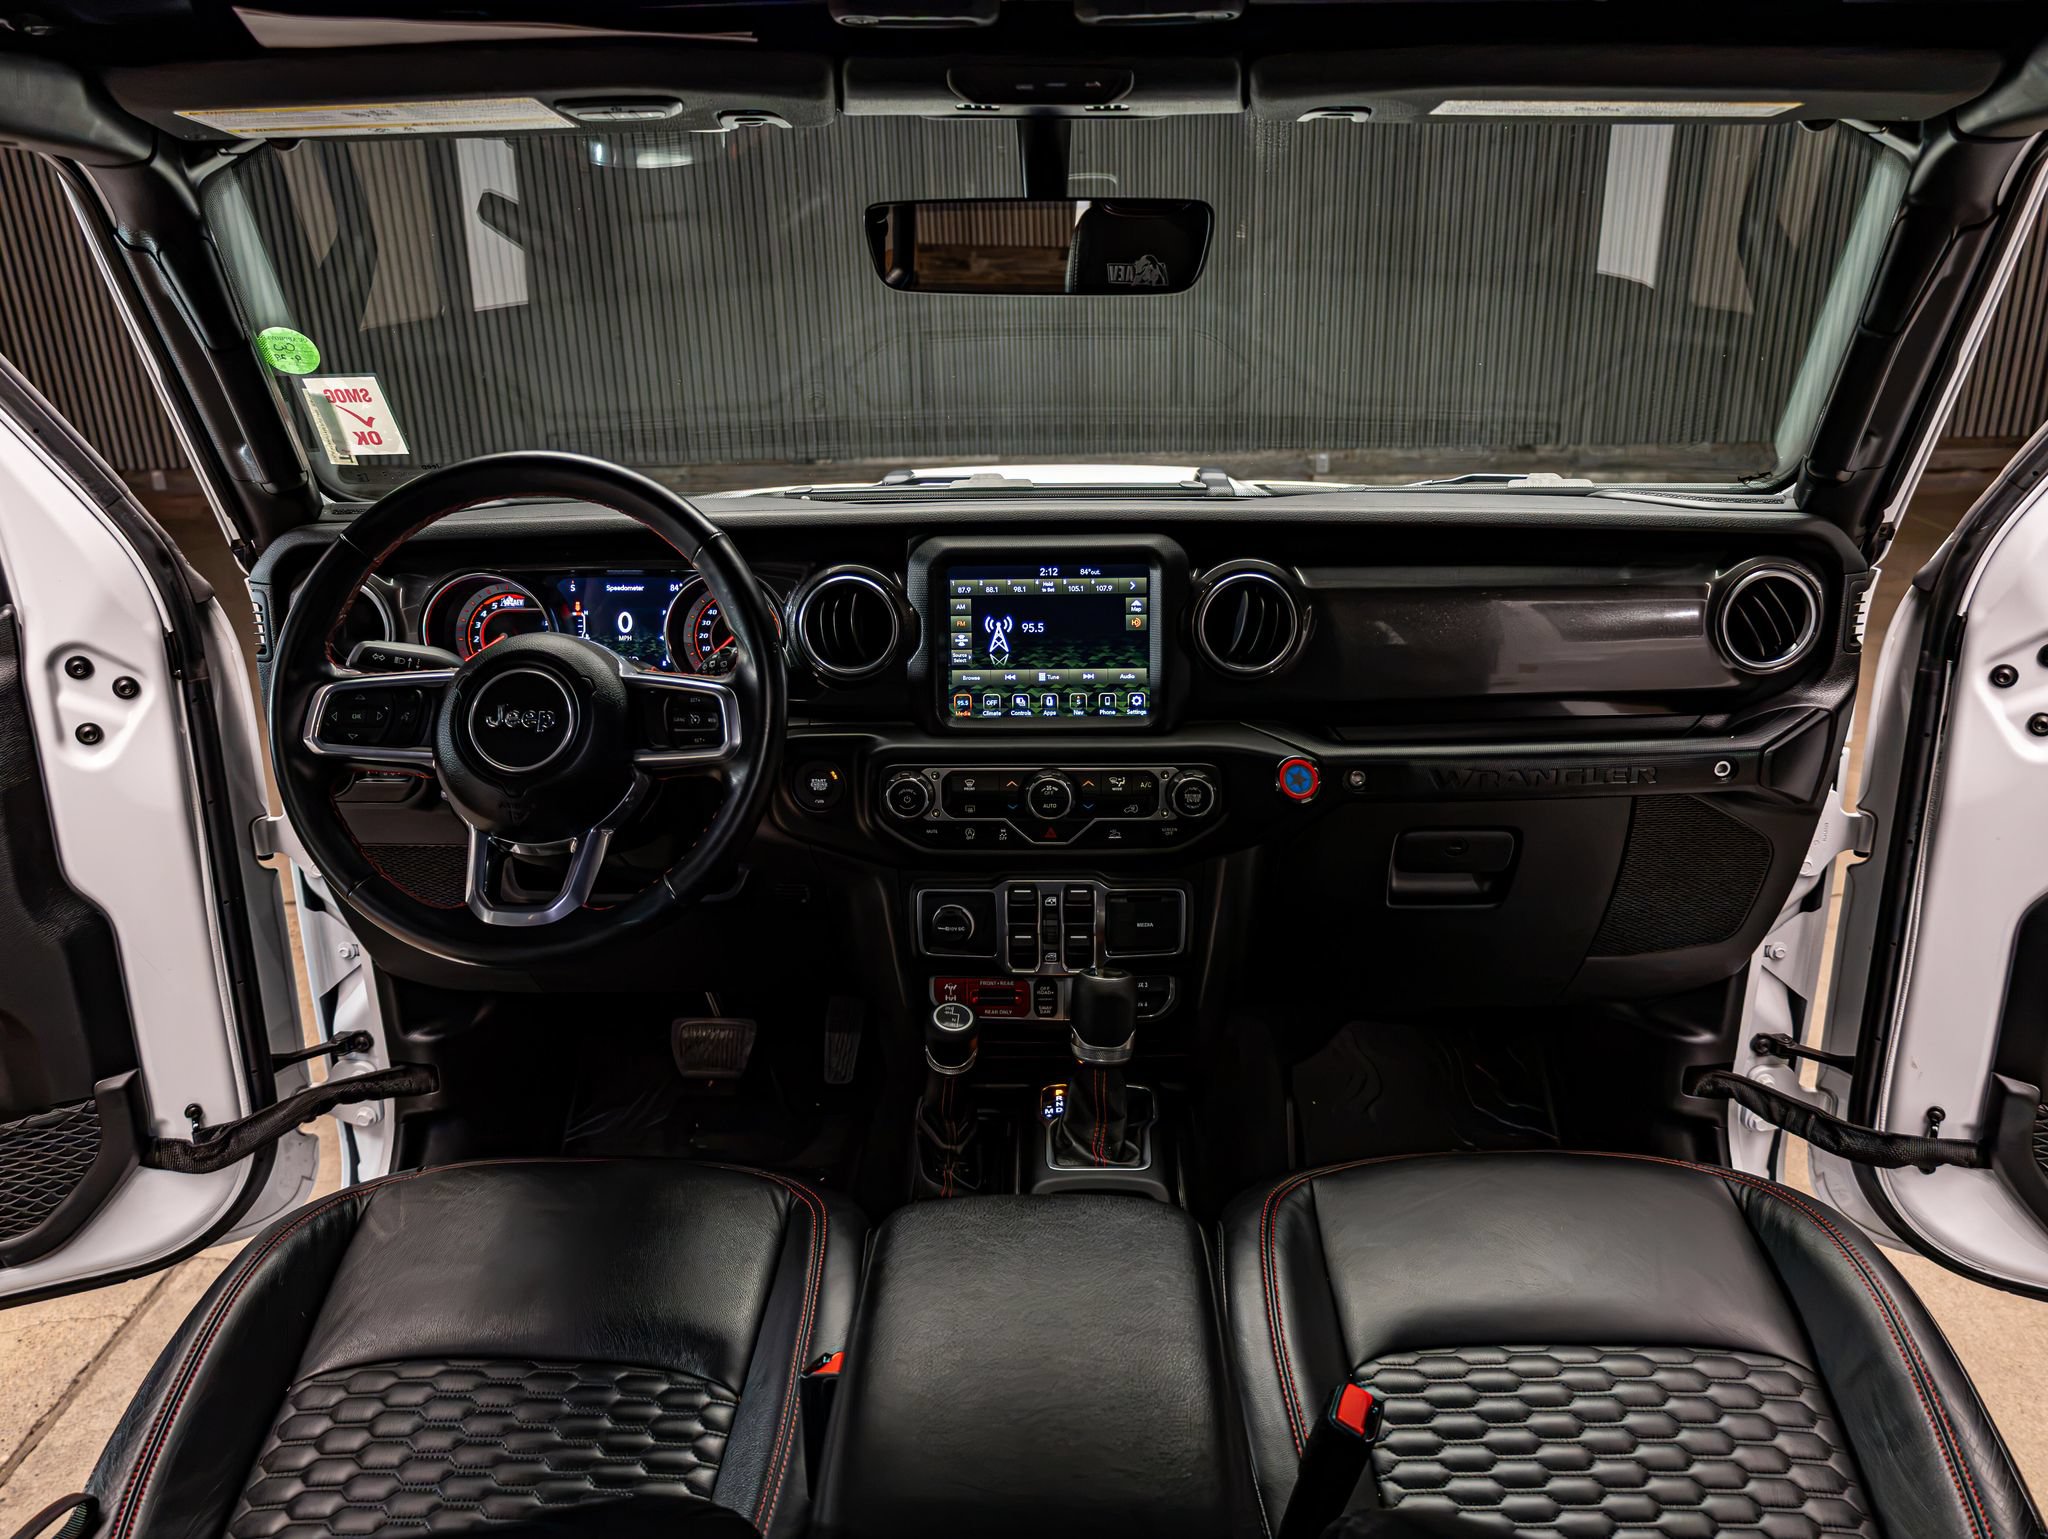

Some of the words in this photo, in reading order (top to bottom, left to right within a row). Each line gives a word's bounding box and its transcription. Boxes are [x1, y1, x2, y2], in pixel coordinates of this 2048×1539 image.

[1039, 567, 1059, 577] 2:12
[570, 584, 576, 592] S
[606, 584, 645, 593] Speedometer
[957, 586, 972, 594] 87.9
[491, 602, 499, 610] 5
[480, 609, 488, 618] 4
[475, 621, 482, 629] 3
[617, 611, 633, 634] 0
[1021, 622, 1044, 633] 95.5
[473, 635, 480, 643] 2
[485, 704, 555, 733] Jeep
